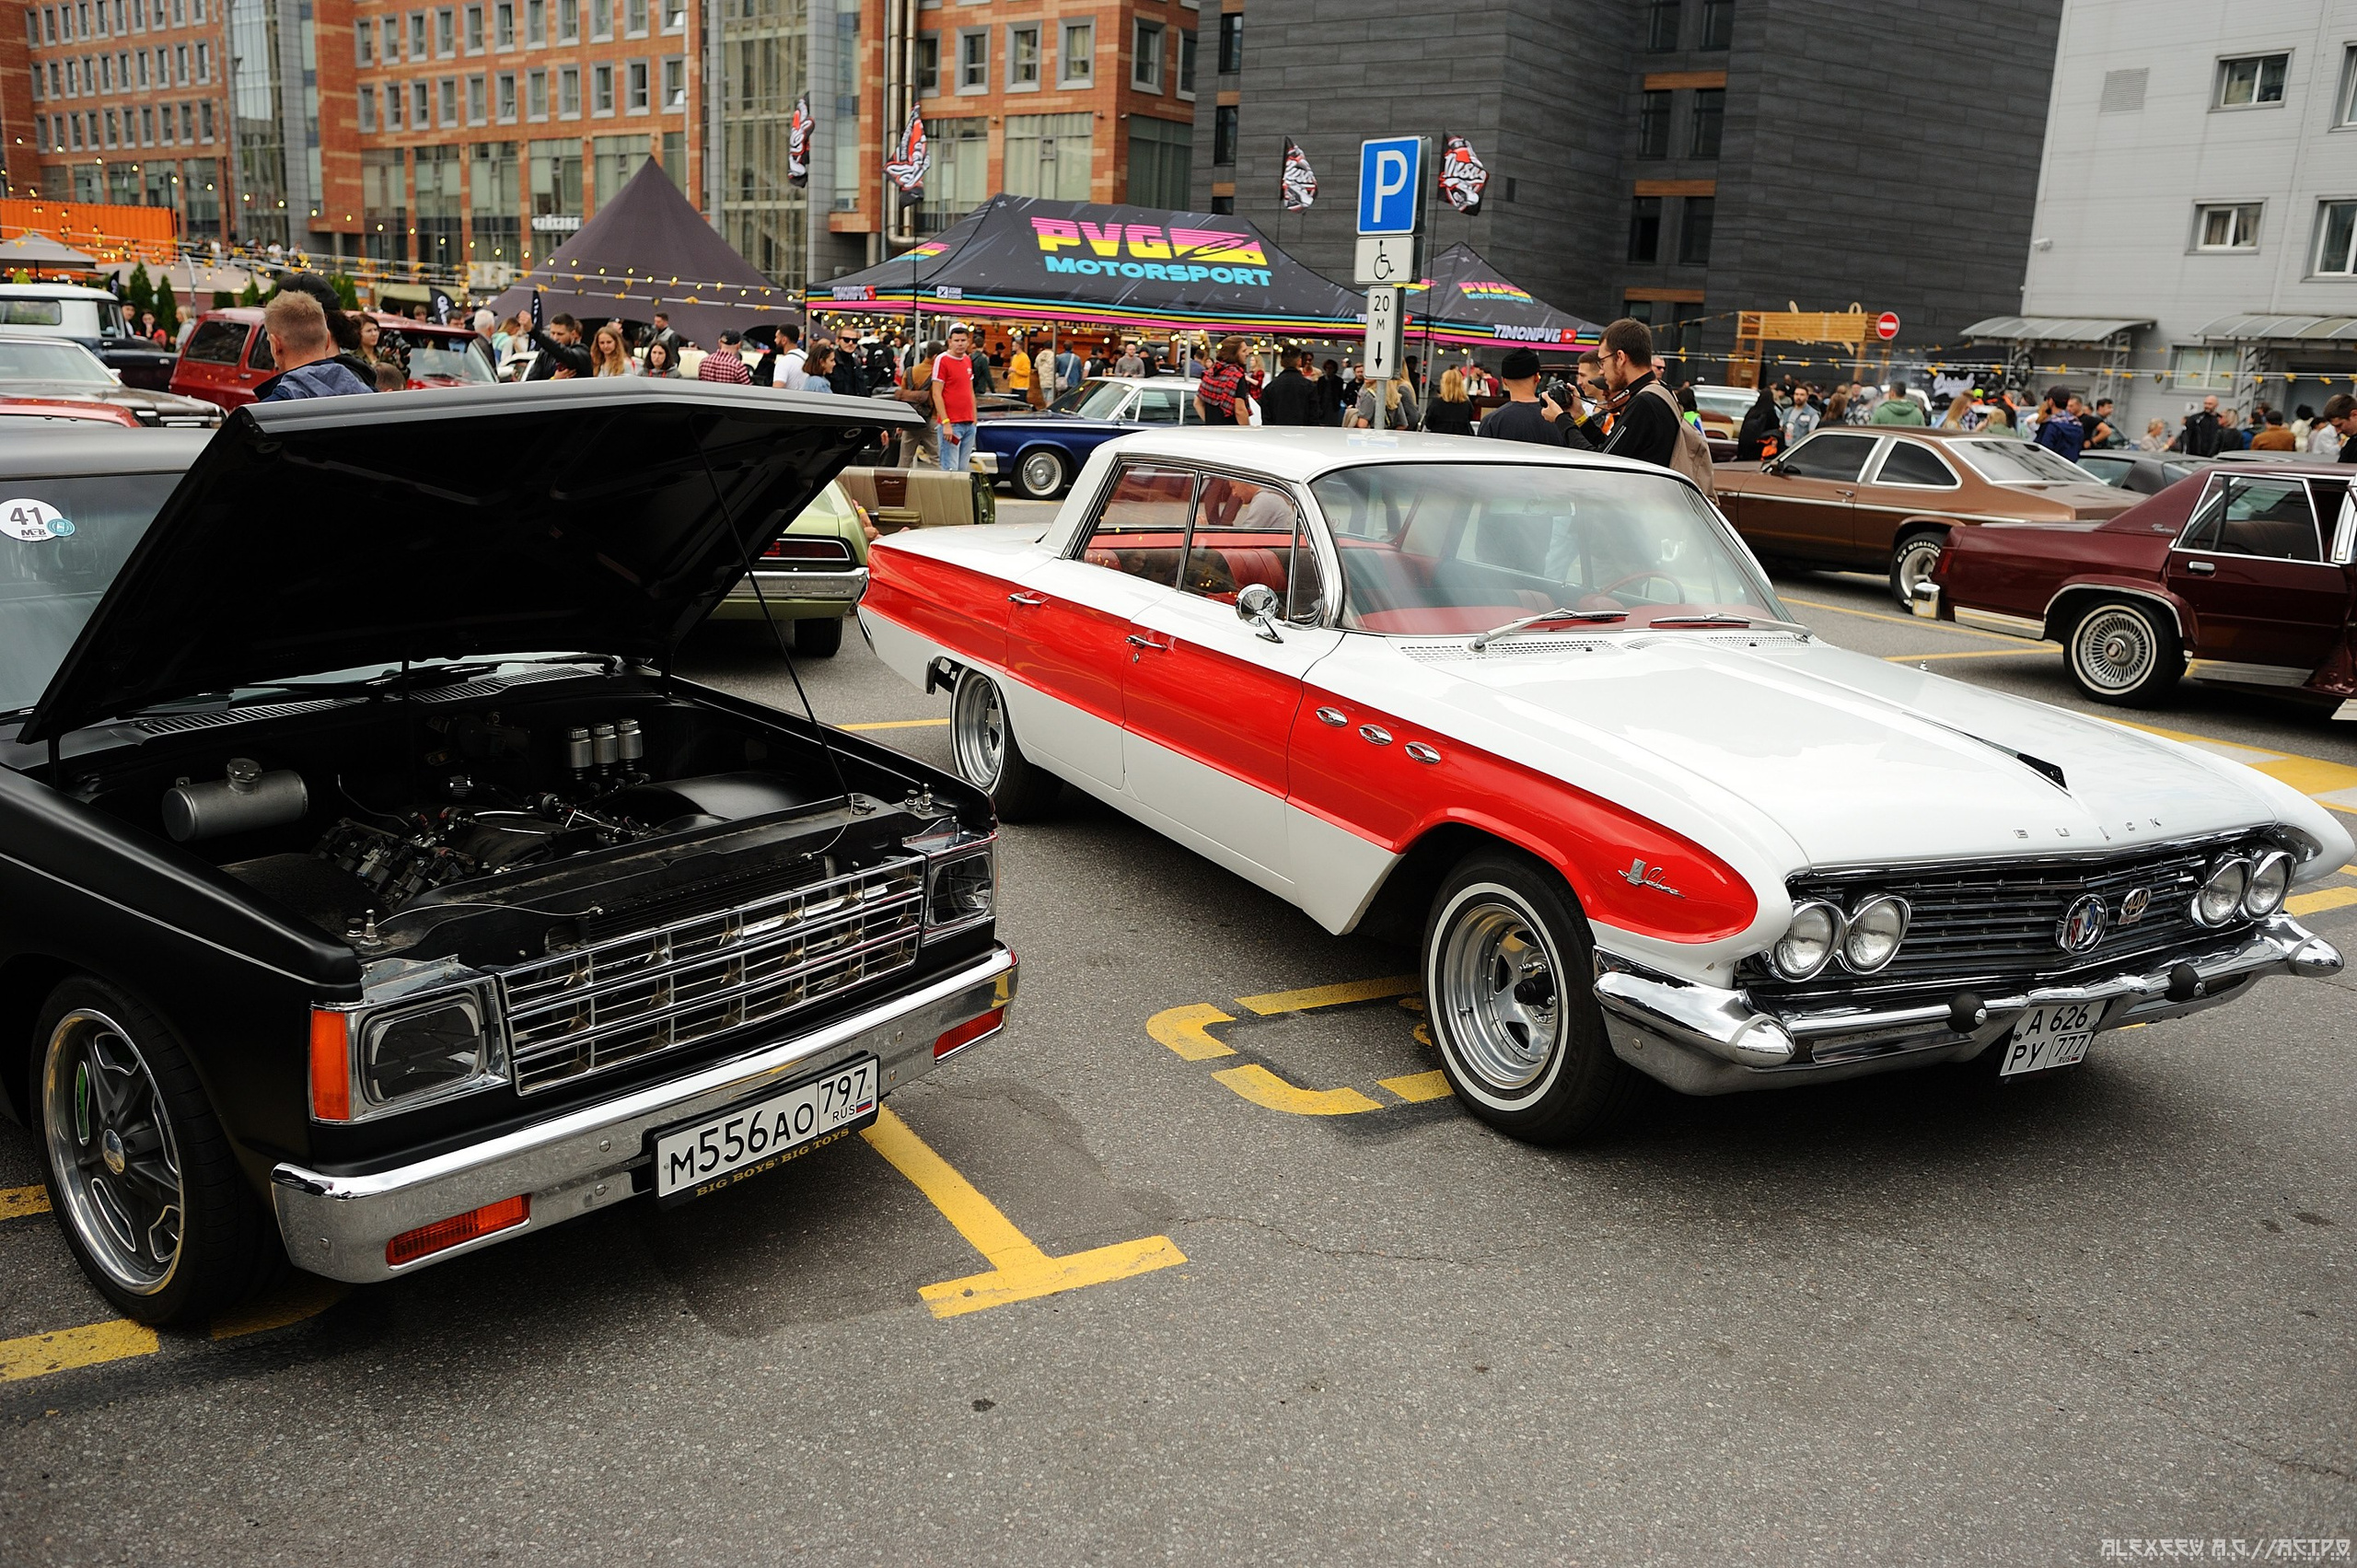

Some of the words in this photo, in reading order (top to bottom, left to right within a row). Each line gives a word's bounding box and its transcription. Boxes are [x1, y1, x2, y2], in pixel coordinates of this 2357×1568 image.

[1373, 150, 1408, 223] P
[1044, 256, 1272, 286] MOTORSPORT
[1374, 295, 1389, 312] 20
[1493, 324, 1562, 343] TIMONPVG
[10, 507, 43, 525] 41
[2014, 818, 2162, 841] BUICK
[2049, 1004, 2090, 1032] 626
[2054, 1034, 2088, 1057] 777
[2058, 1055, 2071, 1063] RUS
[820, 1067, 867, 1115] 797
[832, 1105, 855, 1122] RUS
[696, 1179, 727, 1197] BIG
[732, 1158, 779, 1183] BOYS'
[782, 1146, 809, 1164] BIG
[813, 1128, 850, 1149] TOYS
